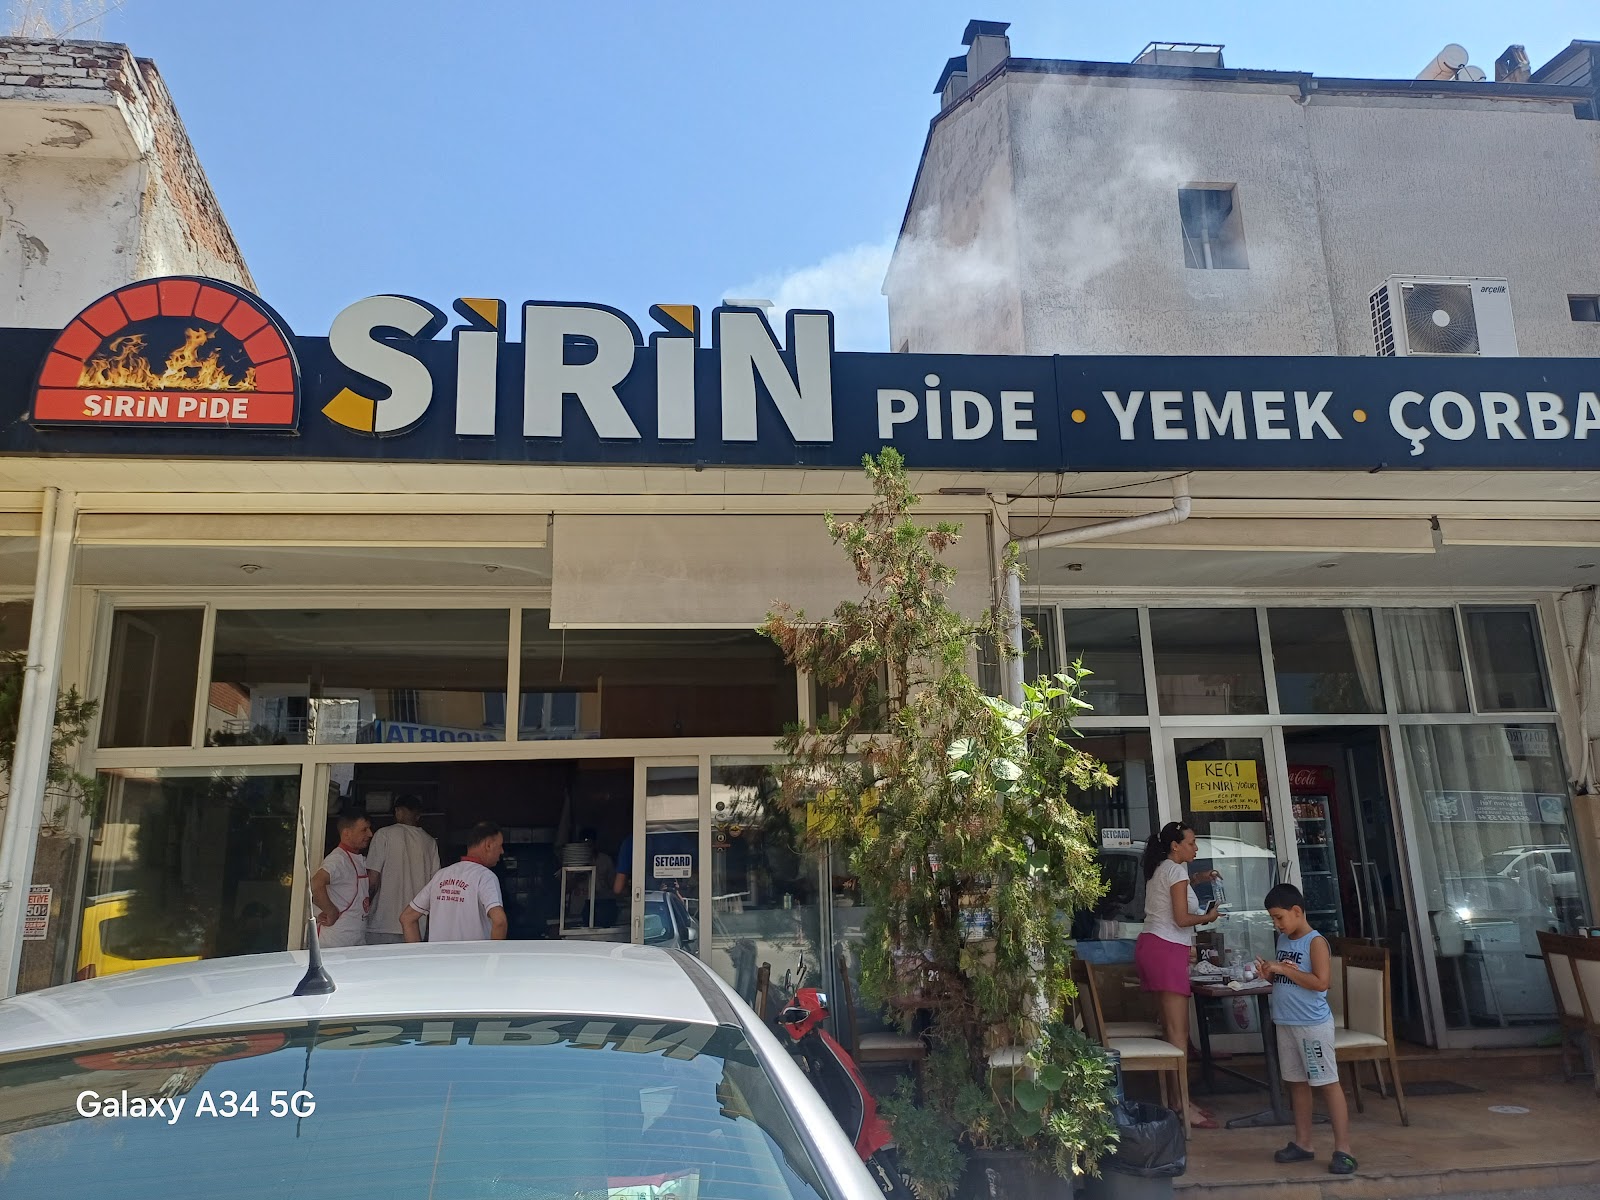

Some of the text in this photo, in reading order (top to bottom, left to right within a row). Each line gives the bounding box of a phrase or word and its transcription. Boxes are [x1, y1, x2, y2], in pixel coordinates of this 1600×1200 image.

[1480, 286, 1506, 294] arçelik
[876, 373, 1038, 441] PİDE
[1101, 390, 1343, 441] YEMEK
[1388, 390, 1600, 457] ÇORBA
[1102, 830, 1130, 839] SETCARD
[655, 856, 690, 867] SETCARD
